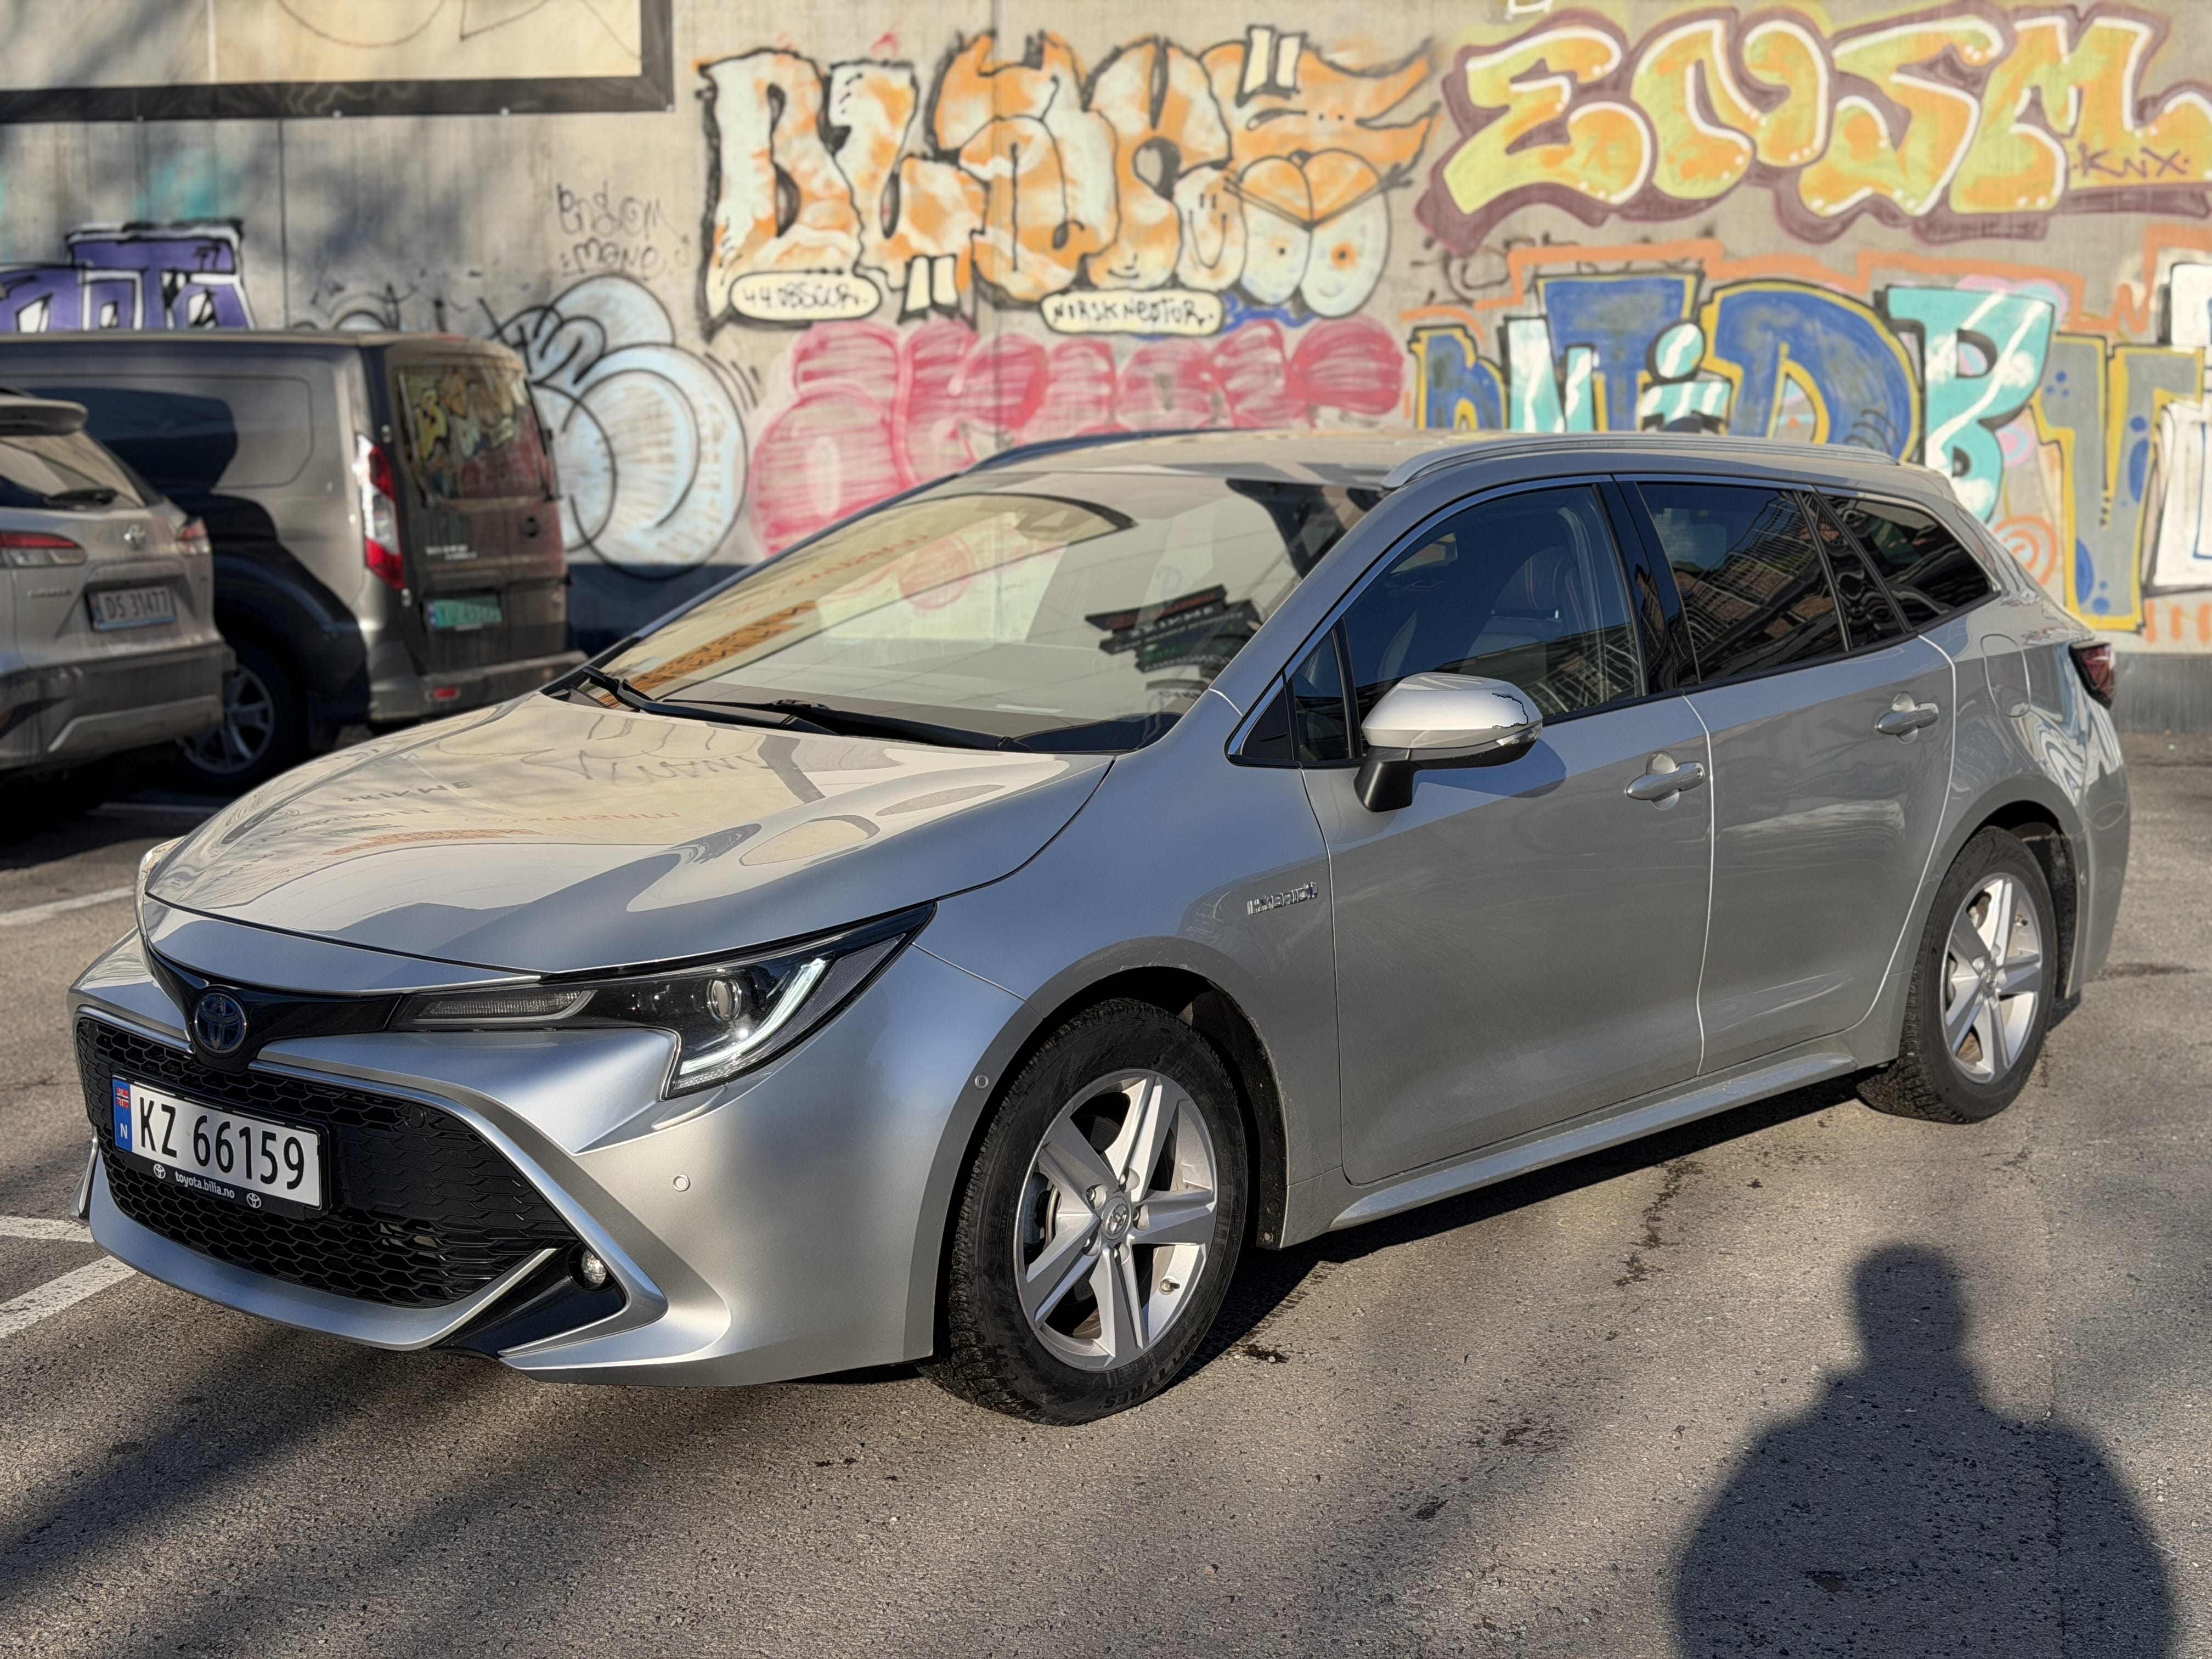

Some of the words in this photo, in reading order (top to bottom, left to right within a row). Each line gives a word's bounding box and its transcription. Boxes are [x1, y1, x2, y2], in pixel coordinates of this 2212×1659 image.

[120, 1122, 128, 1139] N
[139, 1096, 177, 1159] KZ
[193, 1115, 305, 1190] 66159
[174, 1170, 235, 1199] toyota.bilia.no
